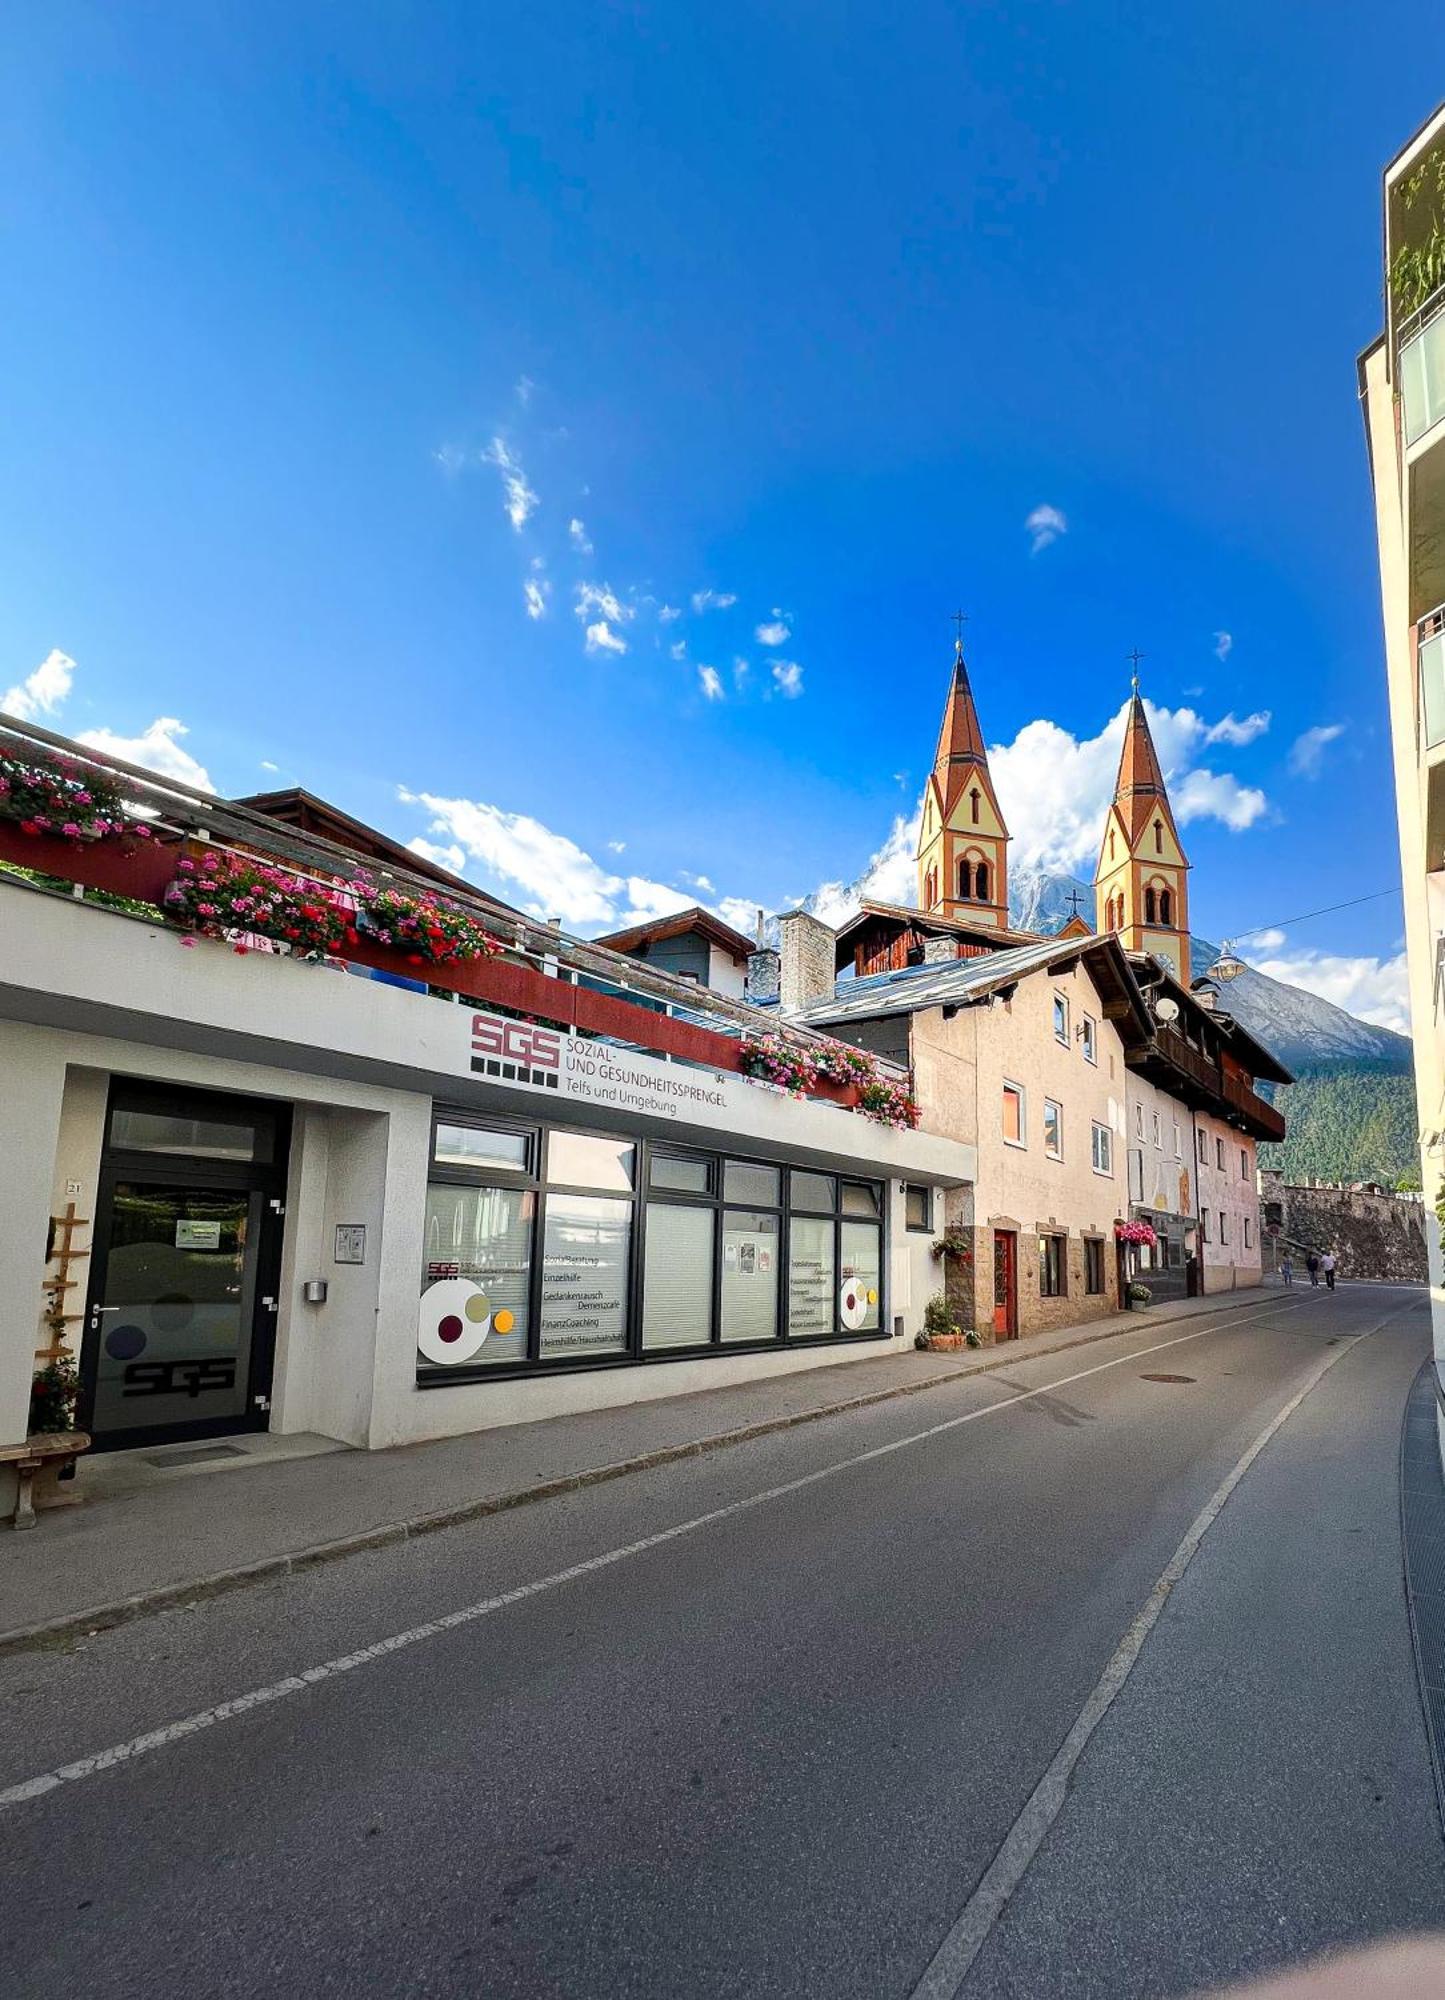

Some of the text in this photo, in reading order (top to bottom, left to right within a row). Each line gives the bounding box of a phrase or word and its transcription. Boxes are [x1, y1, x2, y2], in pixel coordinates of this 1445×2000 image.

[471, 1014, 561, 1069] SGS
[566, 1038, 617, 1062] SOZIAL-
[565, 1077, 677, 1117] Telfs und Umgebung
[566, 1055, 728, 1107] UND GESUNDHEITSSPRENGEL
[427, 1262, 460, 1276] SGS
[122, 1357, 237, 1398] SGS
